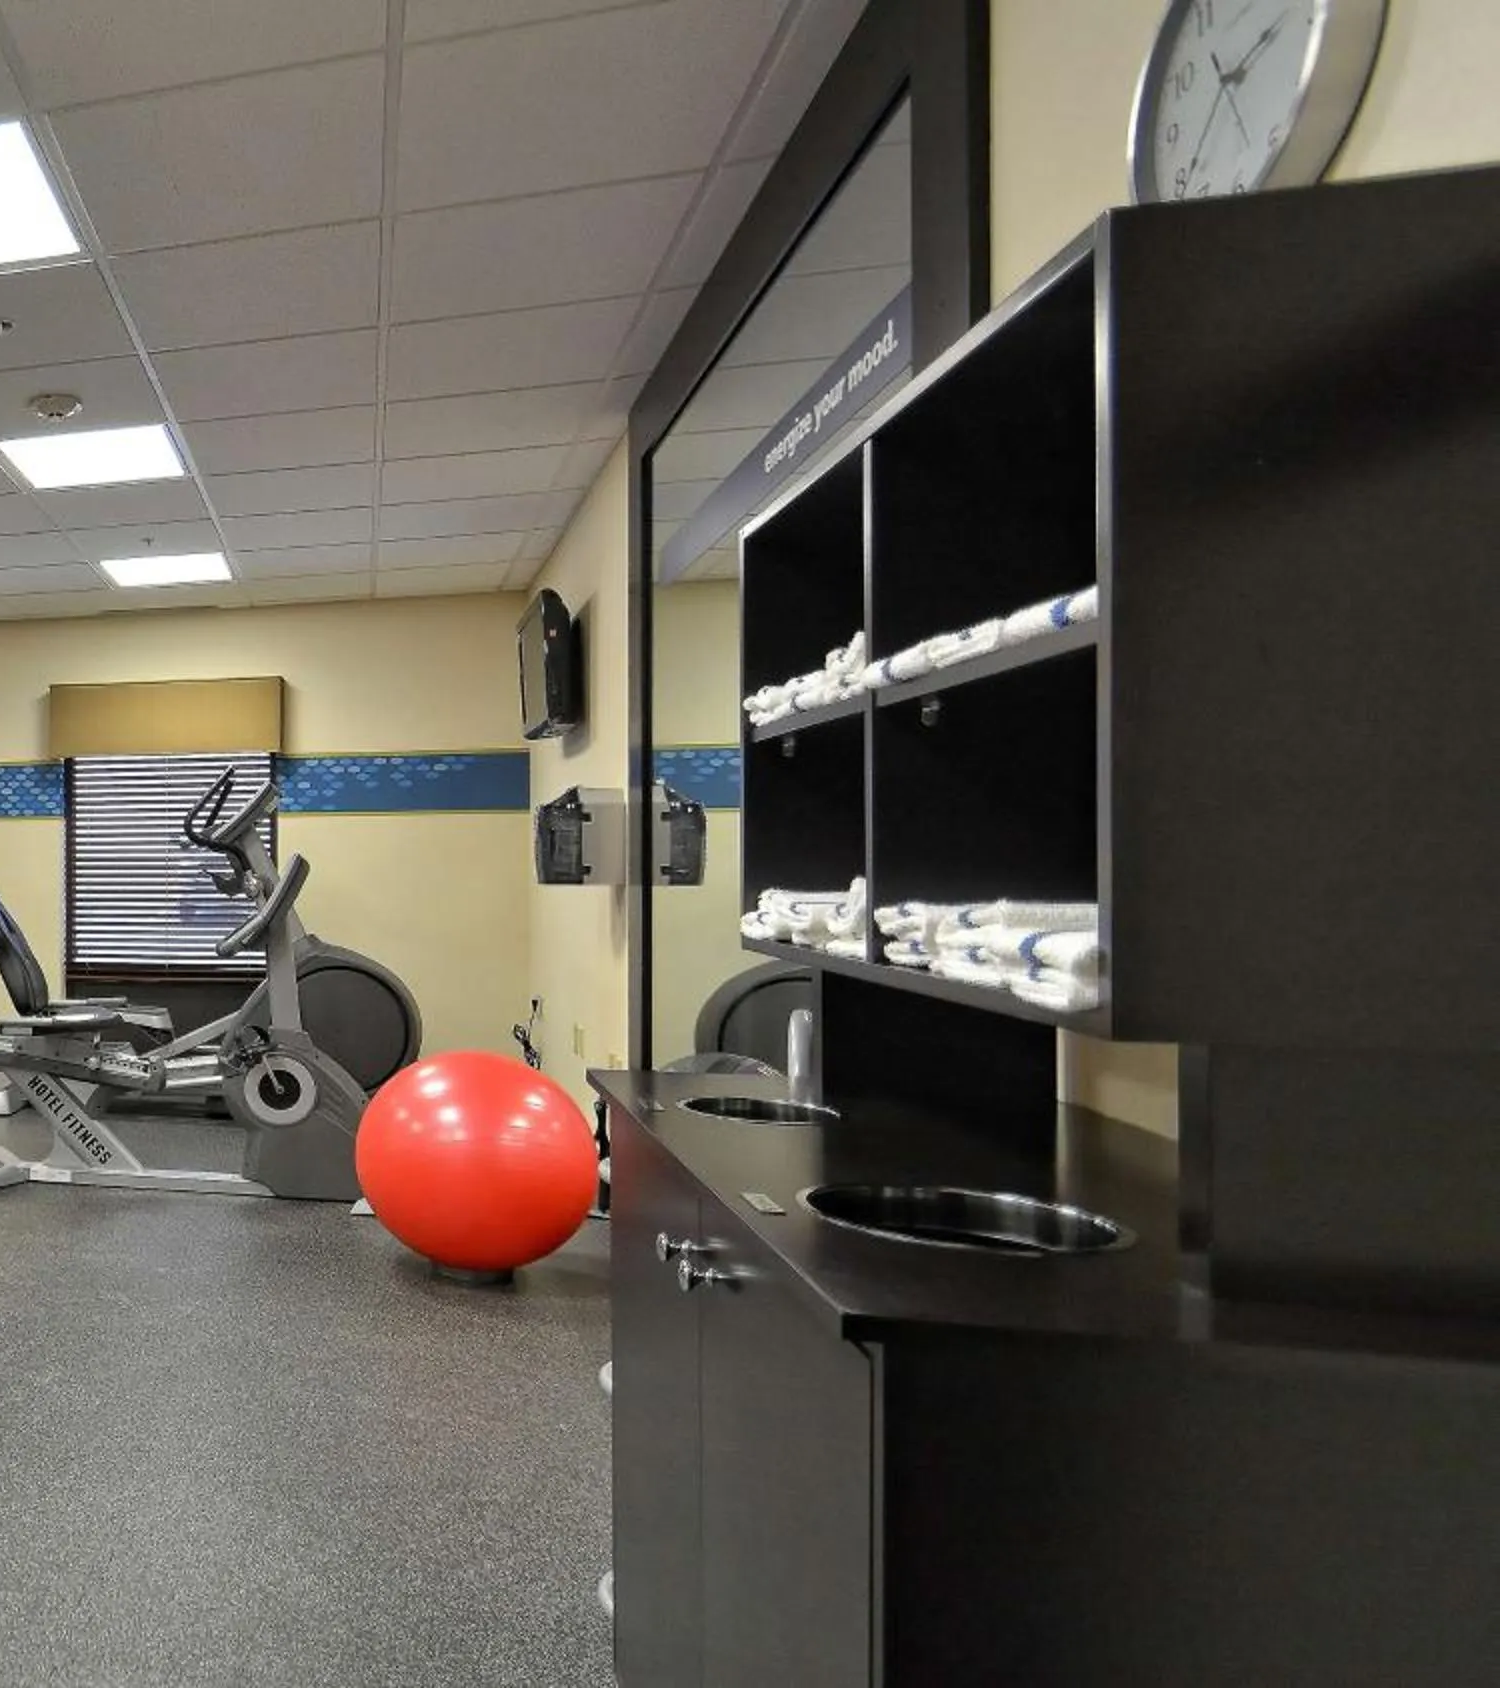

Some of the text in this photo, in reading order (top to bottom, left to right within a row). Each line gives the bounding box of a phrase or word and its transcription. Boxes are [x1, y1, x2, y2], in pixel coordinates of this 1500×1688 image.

[764, 319, 899, 473] energize your mood.
[27, 1074, 113, 1165] HOTEL FITNESS
